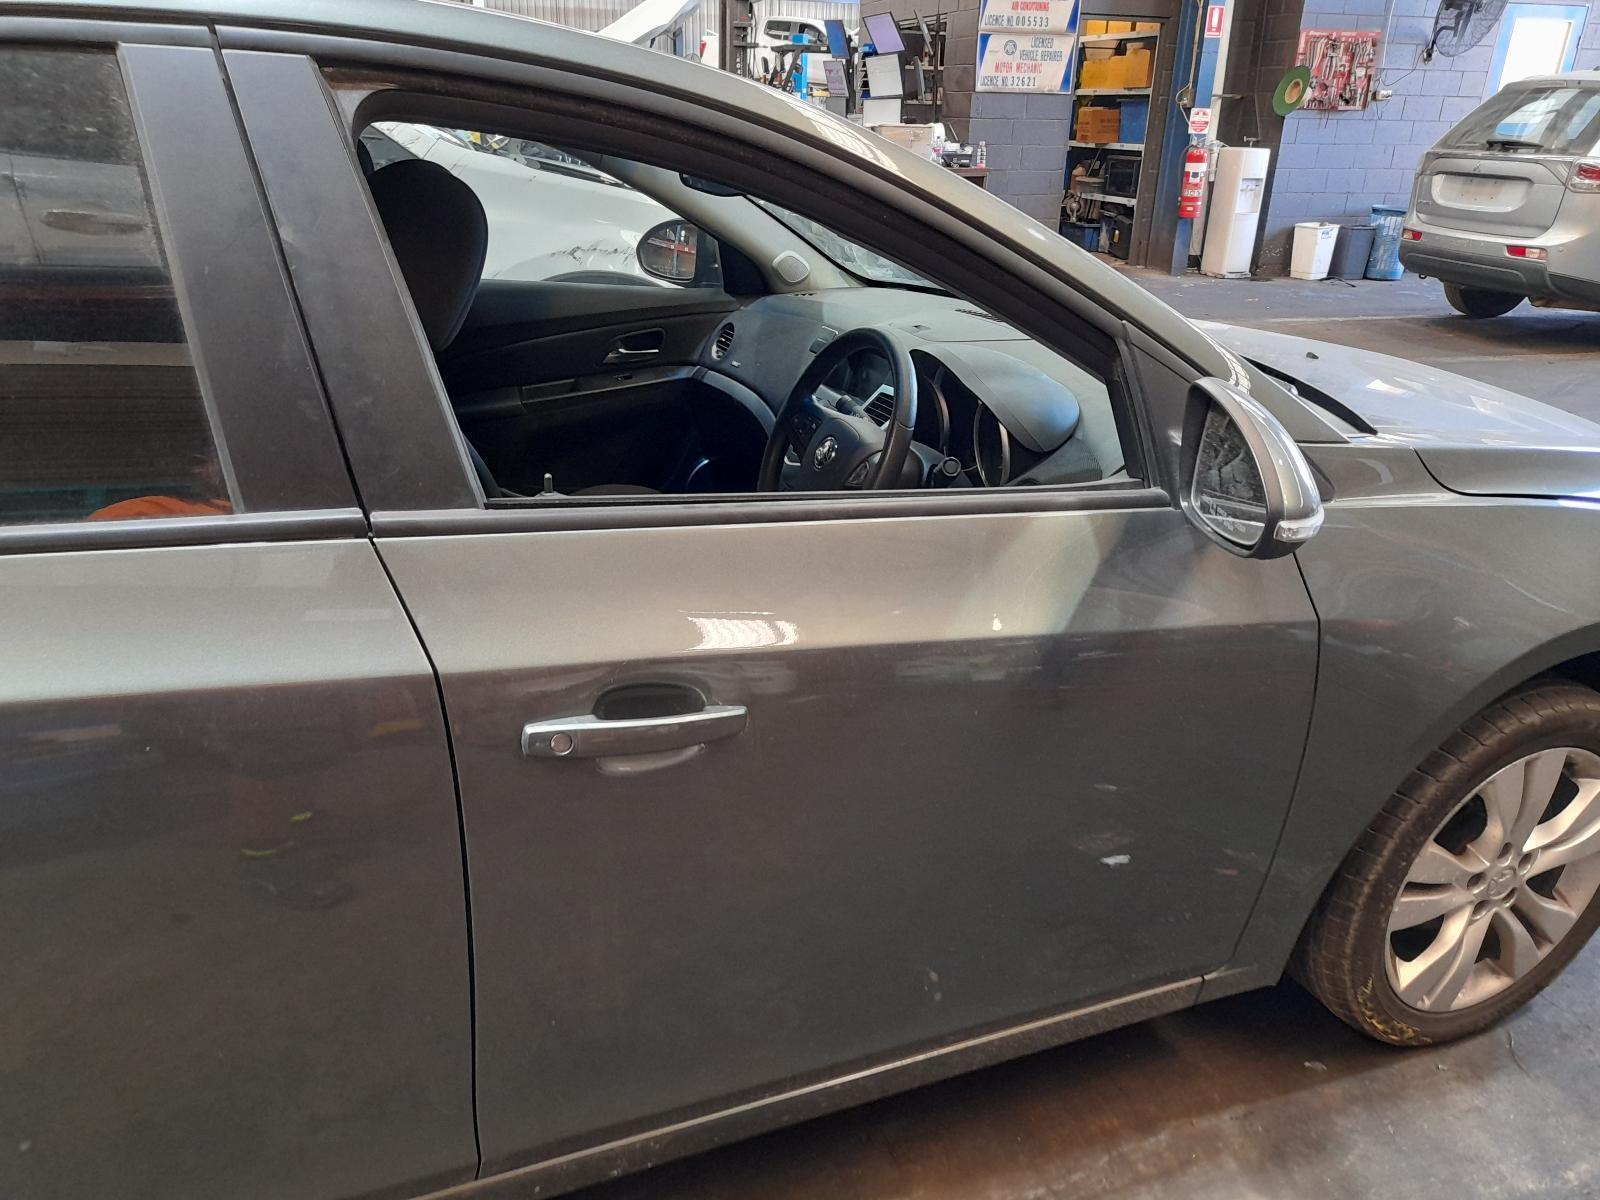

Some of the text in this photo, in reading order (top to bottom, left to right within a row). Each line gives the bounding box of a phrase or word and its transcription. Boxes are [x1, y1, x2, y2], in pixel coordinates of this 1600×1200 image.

[1019, 49, 1039, 61] VEHICLE
[995, 62, 1043, 74] MOTOR MECHANIC
